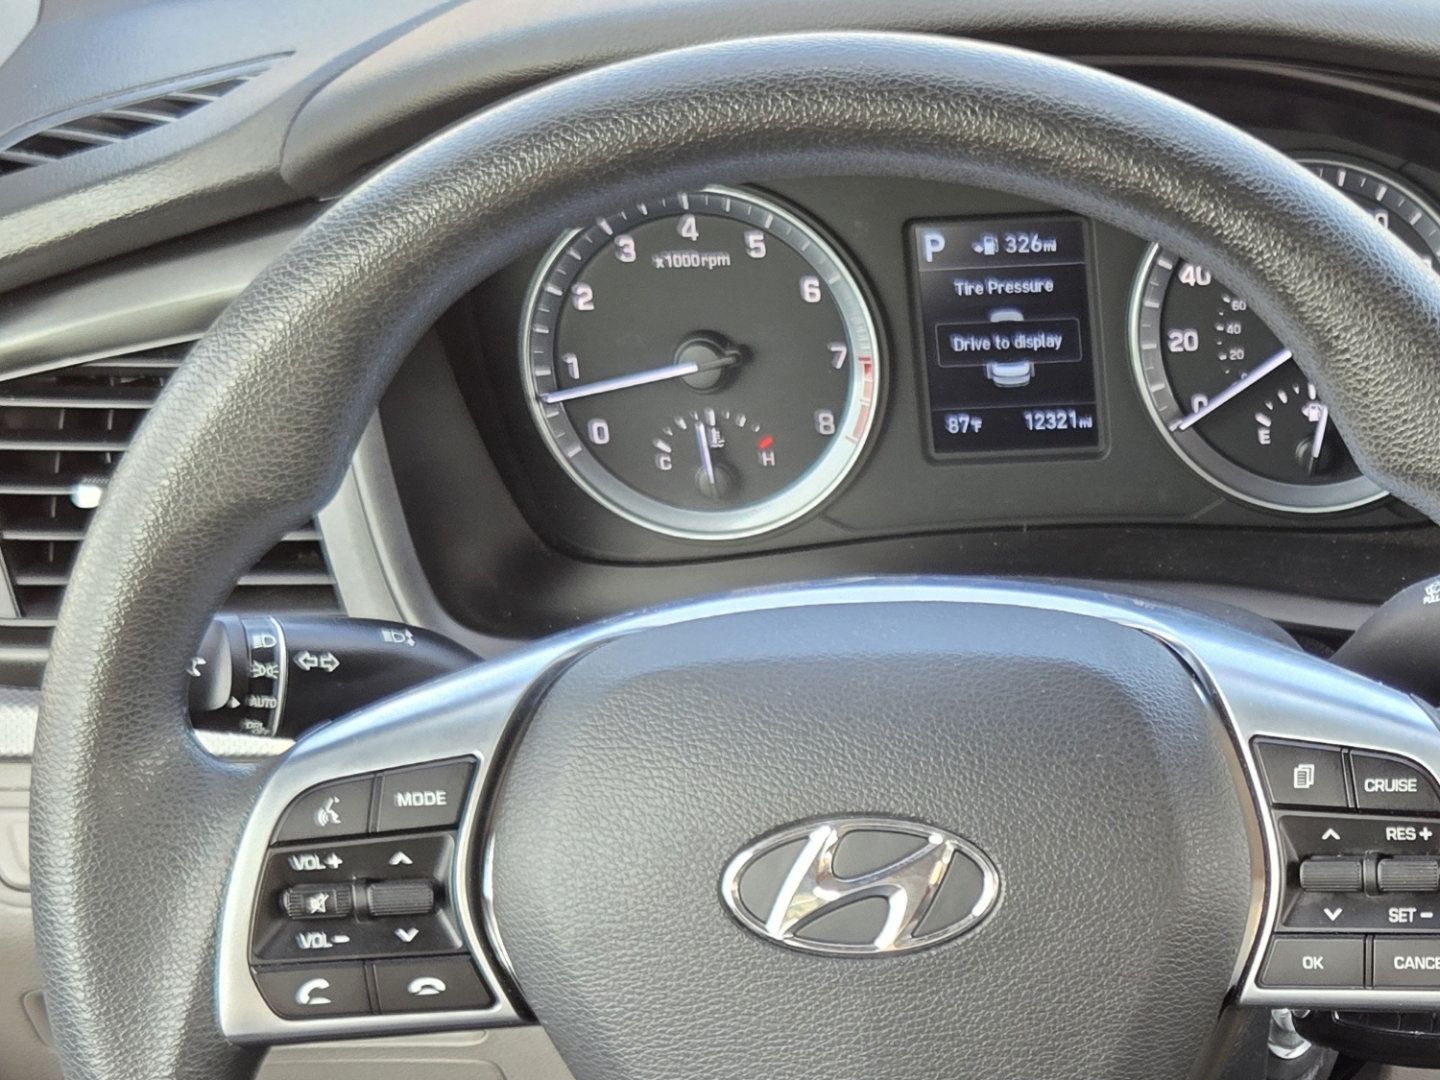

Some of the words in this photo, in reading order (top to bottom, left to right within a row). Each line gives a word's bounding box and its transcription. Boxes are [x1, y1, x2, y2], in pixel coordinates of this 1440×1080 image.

[680, 213, 699, 241] 4
[615, 235, 637, 262] 3
[746, 231, 766, 258] 5
[924, 232, 945, 262] P
[1179, 265, 1211, 286] 40
[572, 282, 595, 310] 2
[801, 276, 822, 303] 6
[954, 278, 984, 296] Tire
[986, 277, 1054, 295] Pressure
[1231, 300, 1247, 311] 60
[1226, 323, 1241, 335] 40
[951, 334, 991, 352] Drive
[995, 335, 1011, 350] to
[1014, 333, 1063, 350] display
[1168, 329, 1199, 352] 20
[828, 342, 847, 369] 7
[1229, 349, 1244, 360] 20
[563, 353, 580, 379] 1
[588, 418, 609, 445] 0
[816, 409, 835, 435] 8
[1257, 428, 1271, 445] E
[656, 454, 672, 470] C
[759, 450, 775, 467] H
[248, 694, 277, 708] AUTO
[1364, 779, 1417, 792] CRUISE
[395, 791, 447, 806] MODE
[1302, 956, 1324, 970] OK
